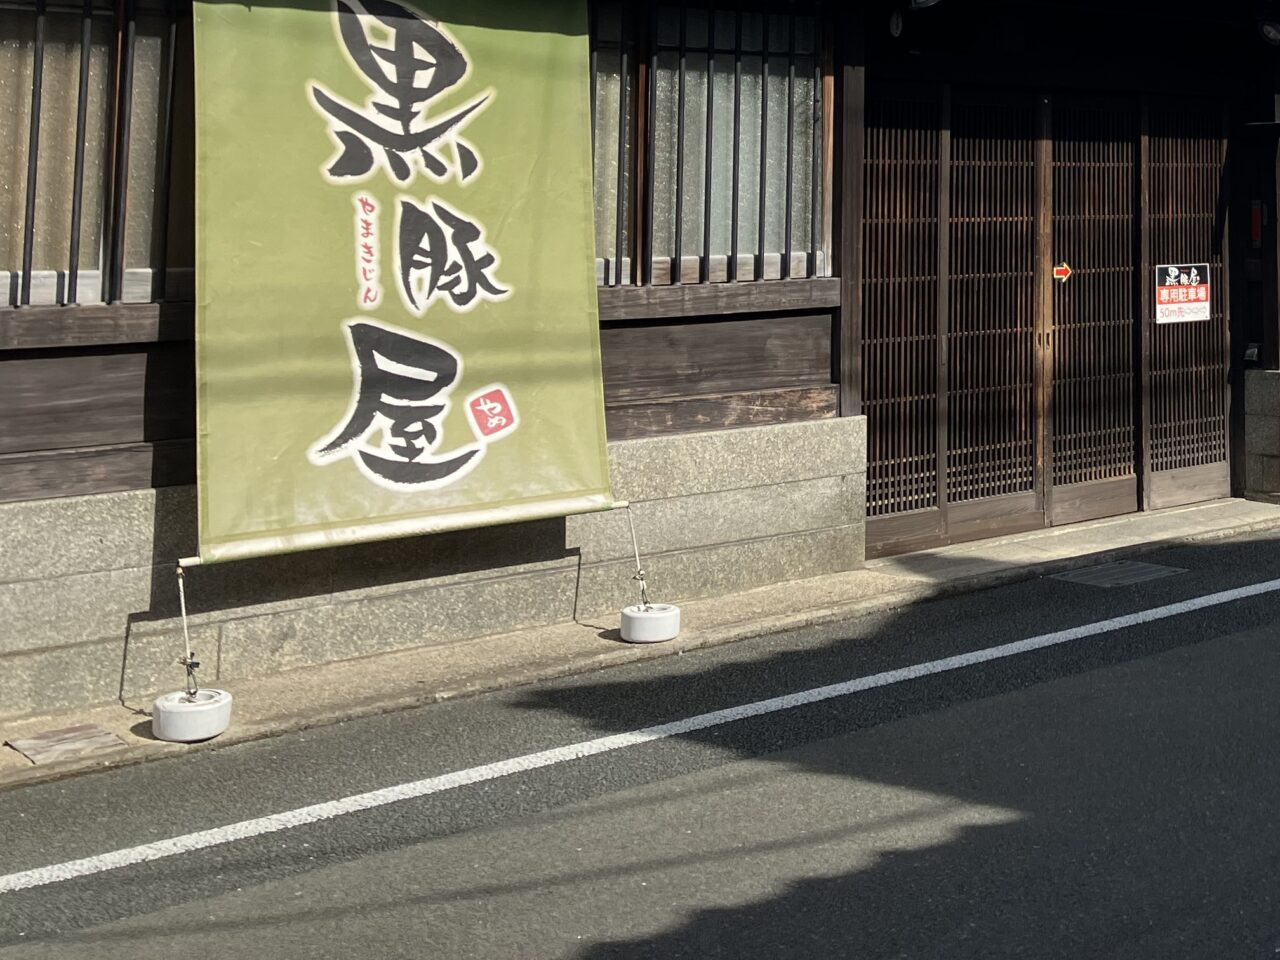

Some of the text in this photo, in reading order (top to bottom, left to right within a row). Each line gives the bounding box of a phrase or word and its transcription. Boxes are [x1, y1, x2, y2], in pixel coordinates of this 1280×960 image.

[1159, 286, 1207, 302] 専用駐車場
